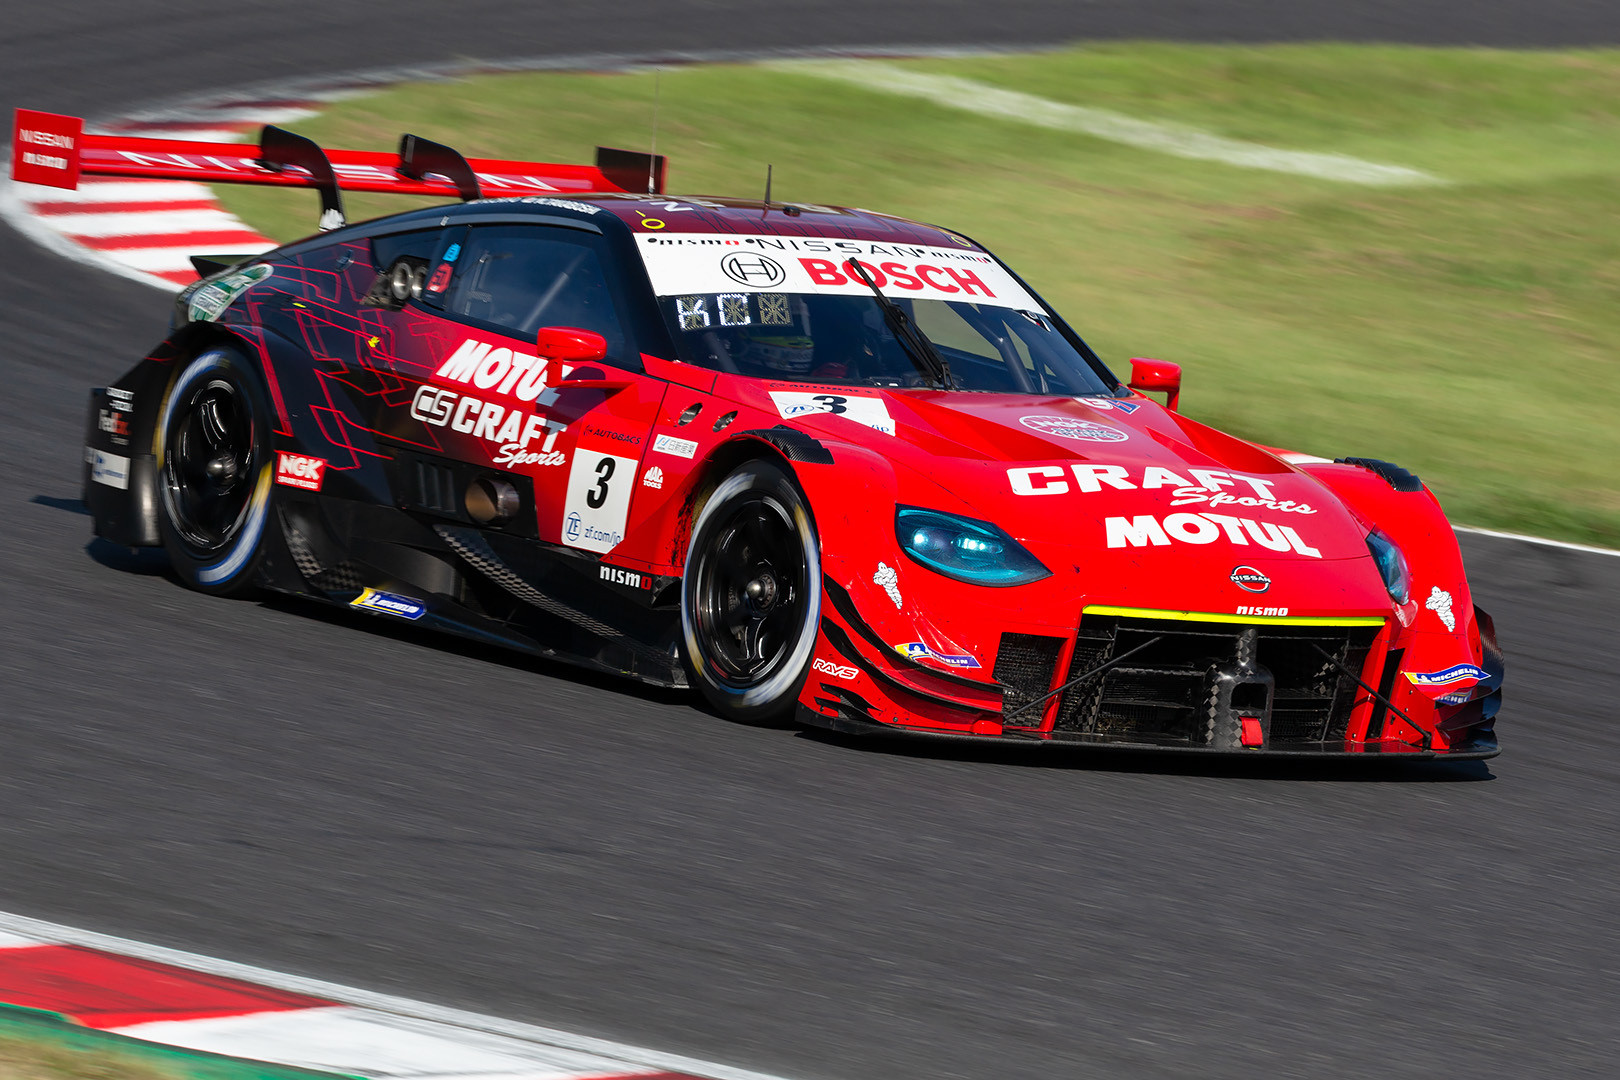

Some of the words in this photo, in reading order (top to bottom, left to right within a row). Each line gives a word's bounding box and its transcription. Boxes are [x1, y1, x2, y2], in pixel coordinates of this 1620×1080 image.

[755, 238, 921, 259] NISSAN
[797, 258, 998, 299] BOSCH
[812, 395, 847, 414] 3
[451, 396, 568, 453] CRAFT
[593, 428, 642, 445] AUTOBACS
[279, 454, 324, 480] NGK
[492, 443, 566, 469] Sports
[586, 456, 616, 510] 3
[643, 480, 662, 490] TOOLS
[1006, 464, 1278, 501] CRAFT
[1169, 487, 1318, 515] Sports
[566, 514, 582, 539] ZF
[1104, 512, 1324, 559] MOTUL
[600, 565, 652, 591] nismo
[1230, 575, 1272, 584] NISSAN
[812, 658, 860, 680] RAYS
[1430, 667, 1479, 683] MICHELIN
